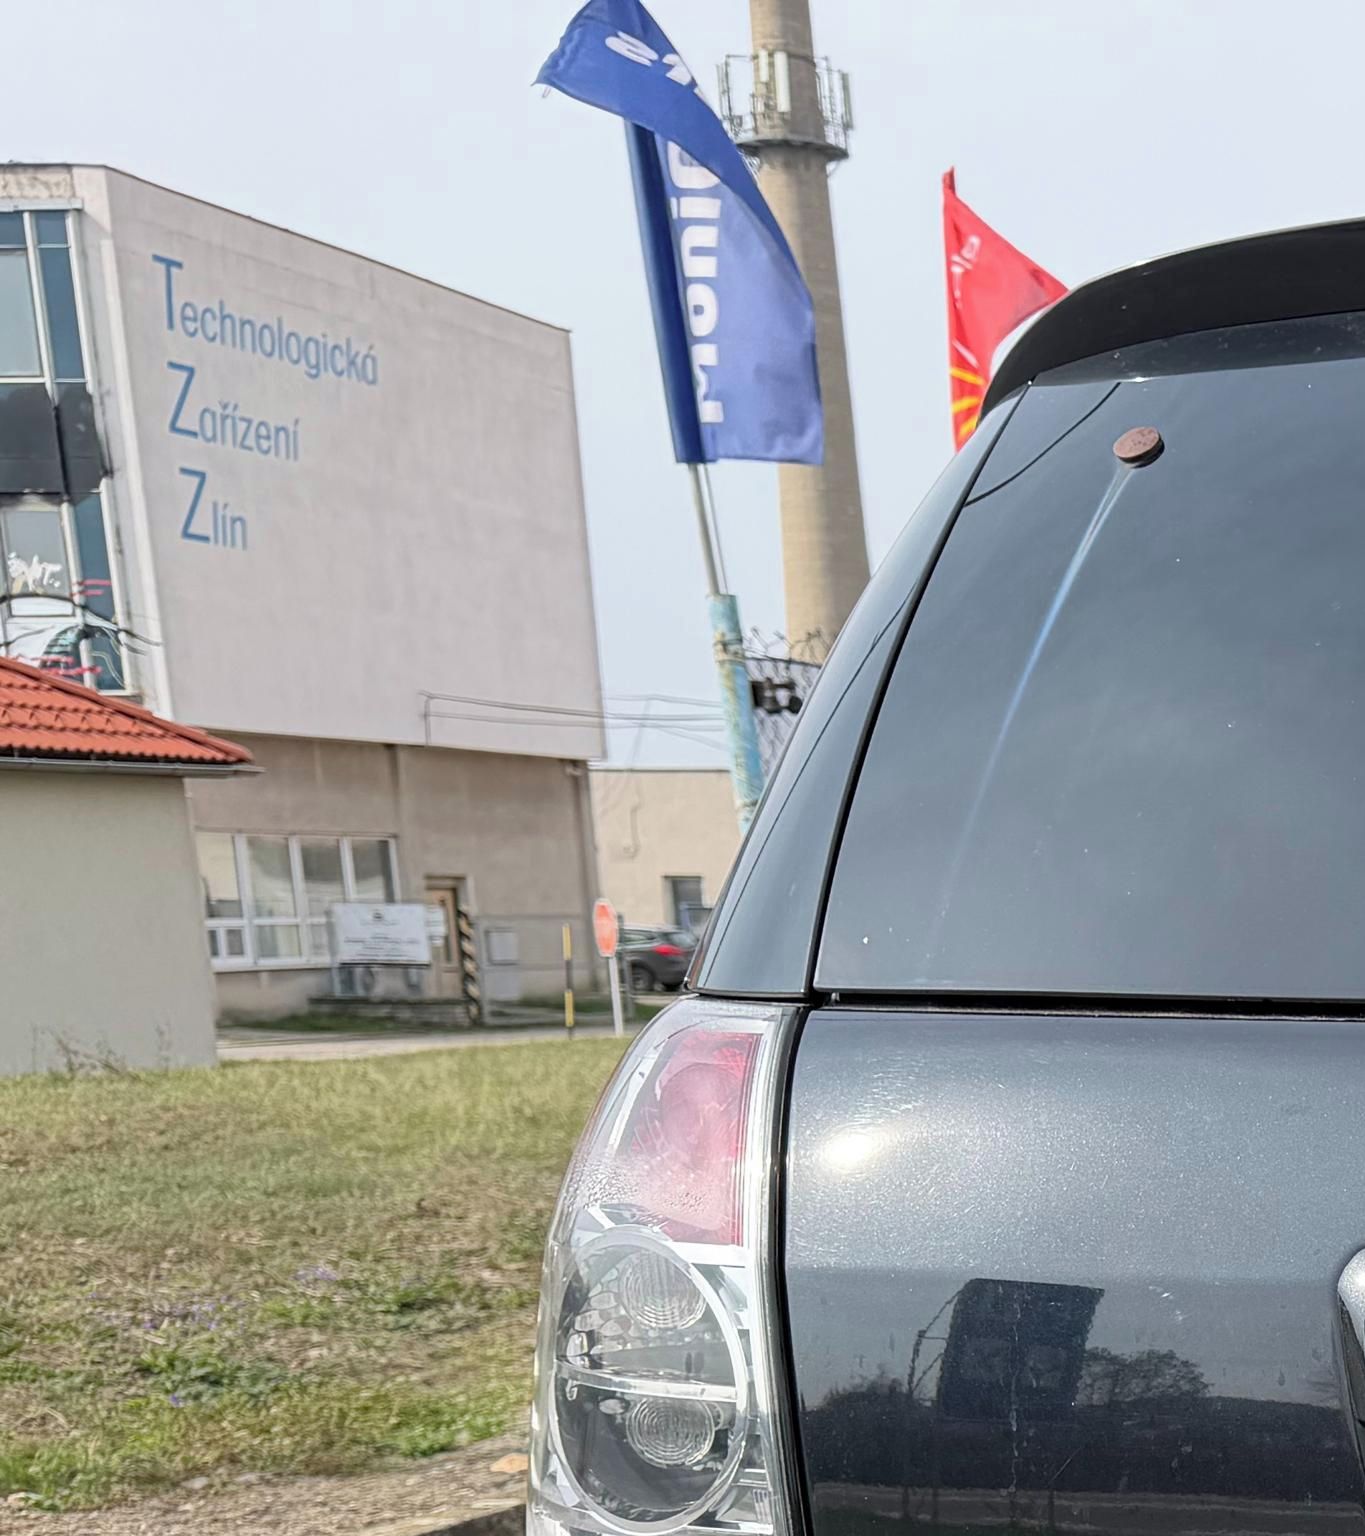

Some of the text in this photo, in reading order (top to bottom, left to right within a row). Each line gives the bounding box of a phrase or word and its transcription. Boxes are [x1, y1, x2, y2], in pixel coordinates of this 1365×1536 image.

[152, 253, 378, 387] Technologická
[166, 360, 299, 462] Zařízení
[178, 466, 248, 550] Zlín
